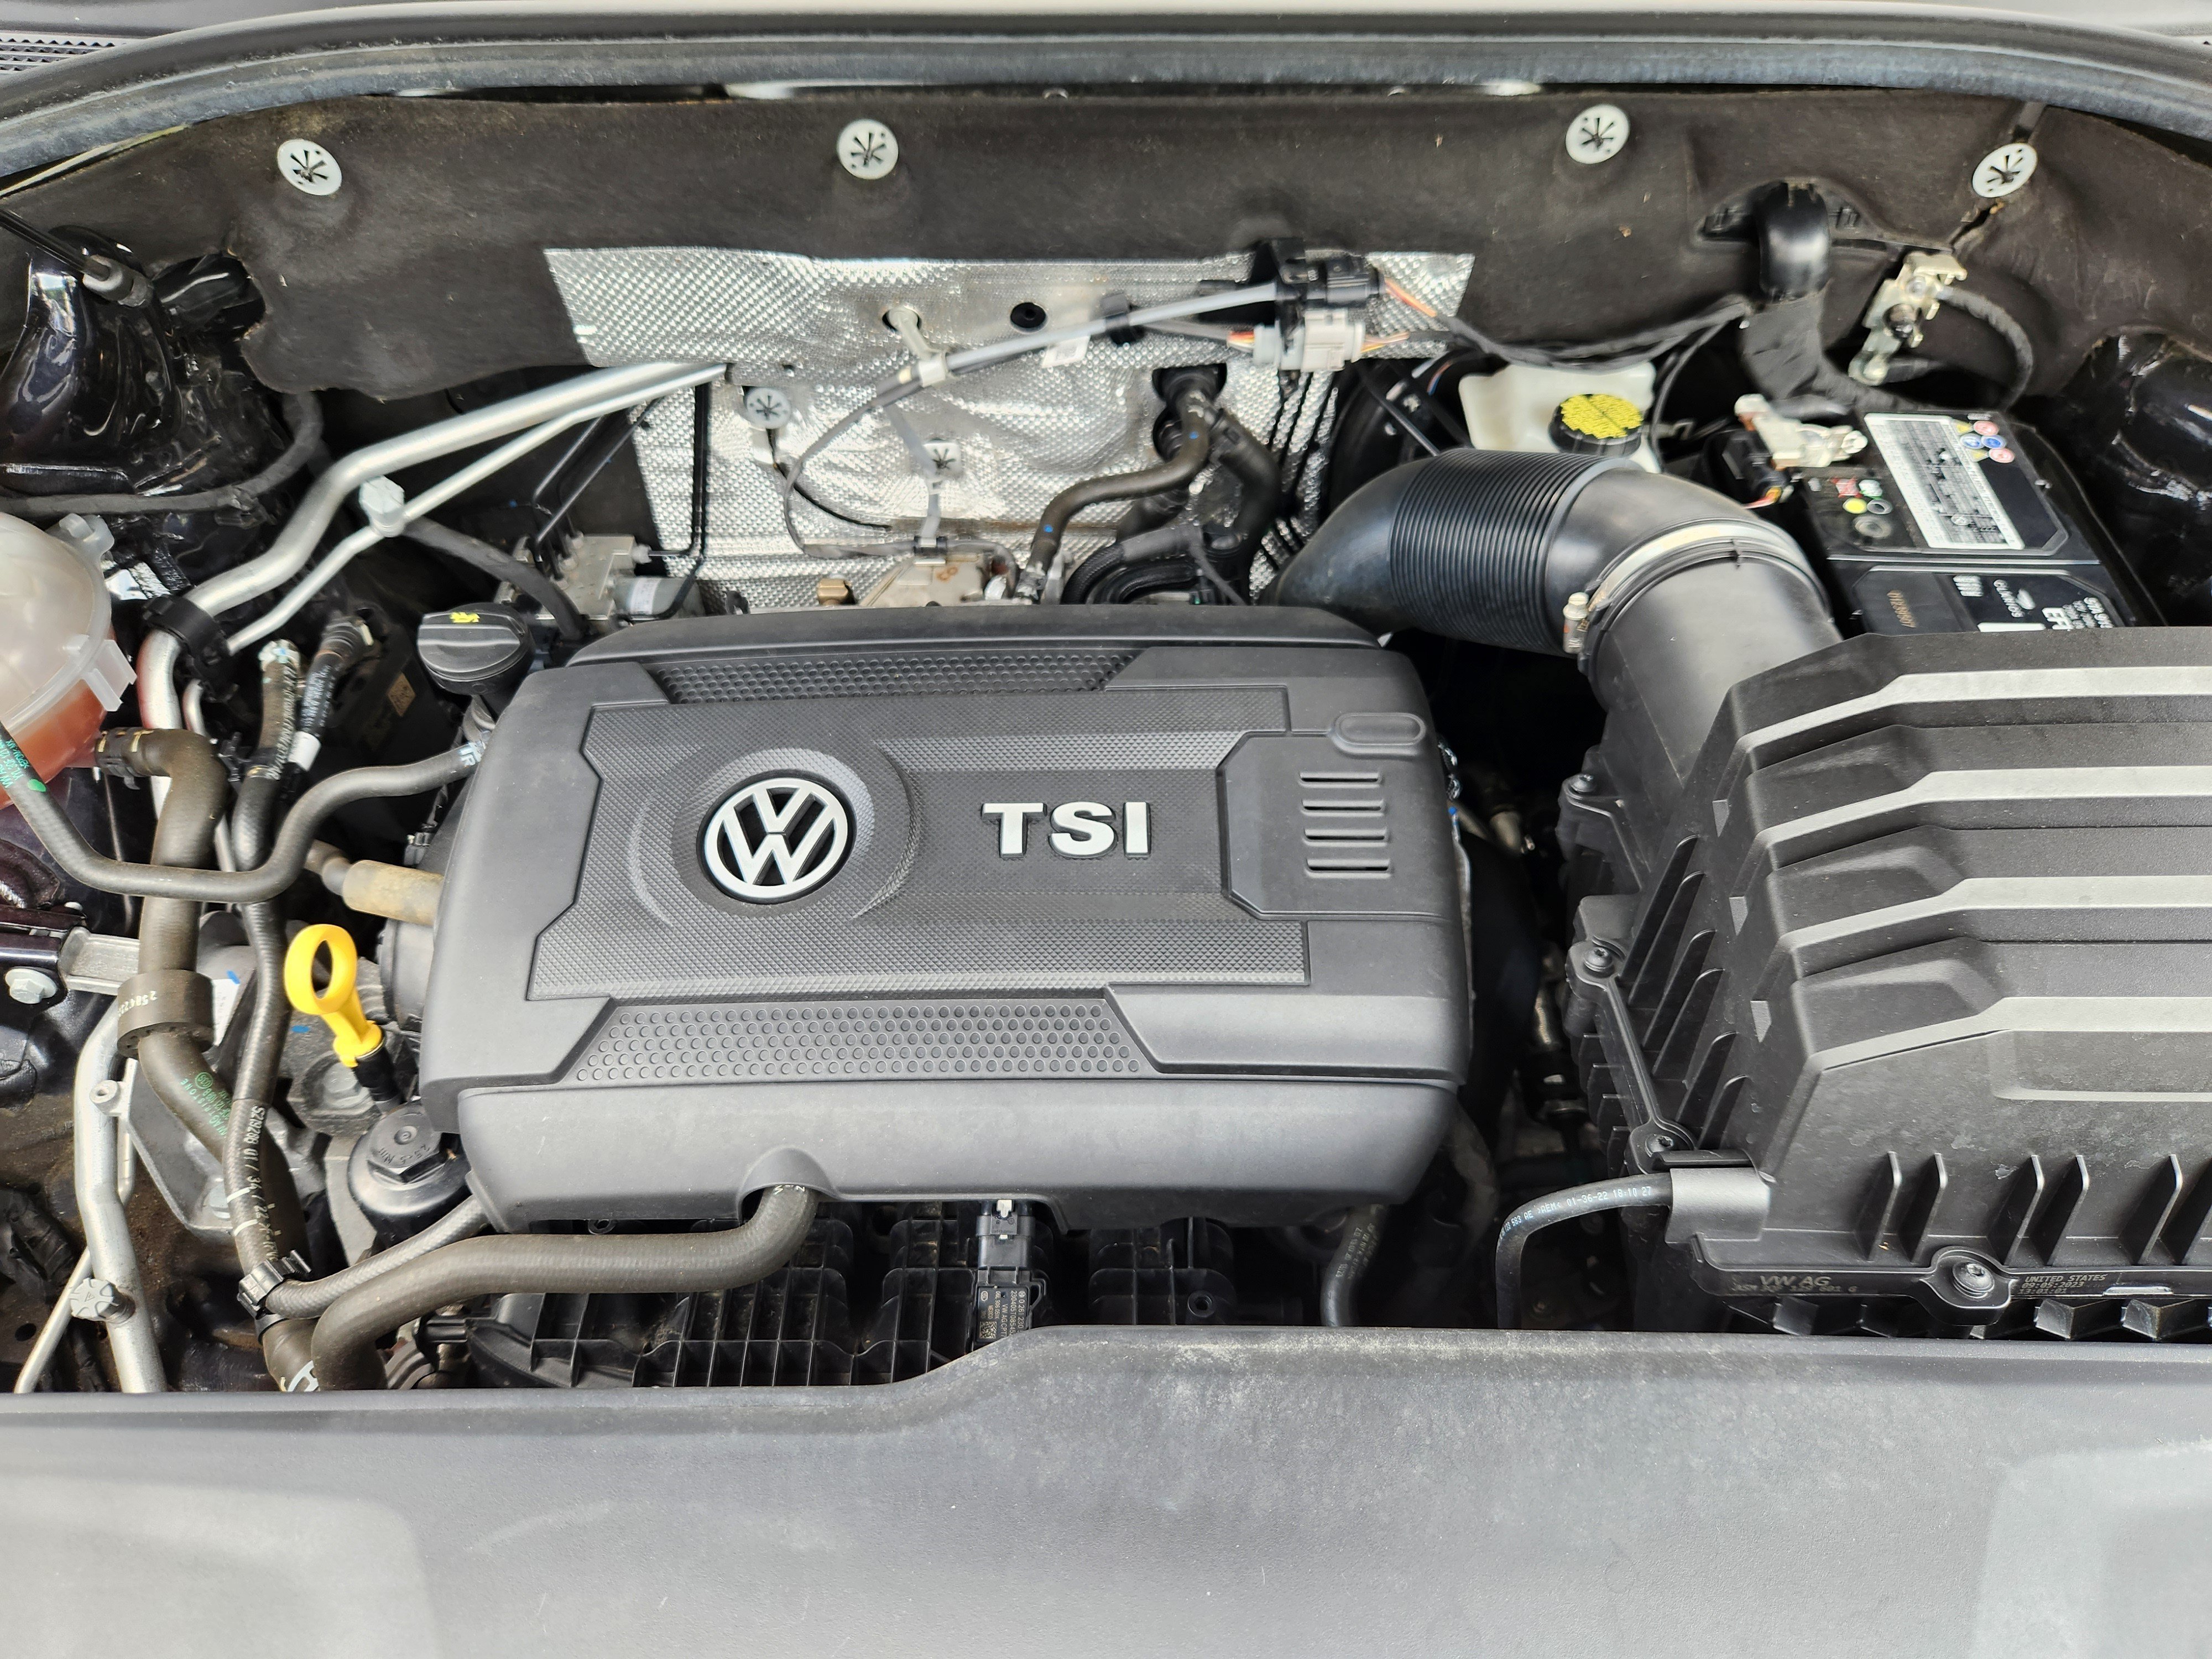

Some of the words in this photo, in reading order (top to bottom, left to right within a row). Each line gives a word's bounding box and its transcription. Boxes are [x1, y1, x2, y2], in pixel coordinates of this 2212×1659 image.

[703, 778, 848, 898] VW
[982, 801, 1151, 858] TSI
[180, 1077, 216, 1117] TRISTONE
[1524, 1209, 1533, 1220] AE
[1567, 1191, 1608, 1207] 01-36-22
[1613, 1187, 1637, 1198] 18:10
[1642, 1186, 1652, 1197] 27
[1760, 1275, 1798, 1286] VW
[1798, 1275, 1832, 1287] AG
[2067, 1274, 2108, 1282] STATES
[1002, 1303, 1008, 1313] VW
[1001, 1314, 1007, 1323] AG
